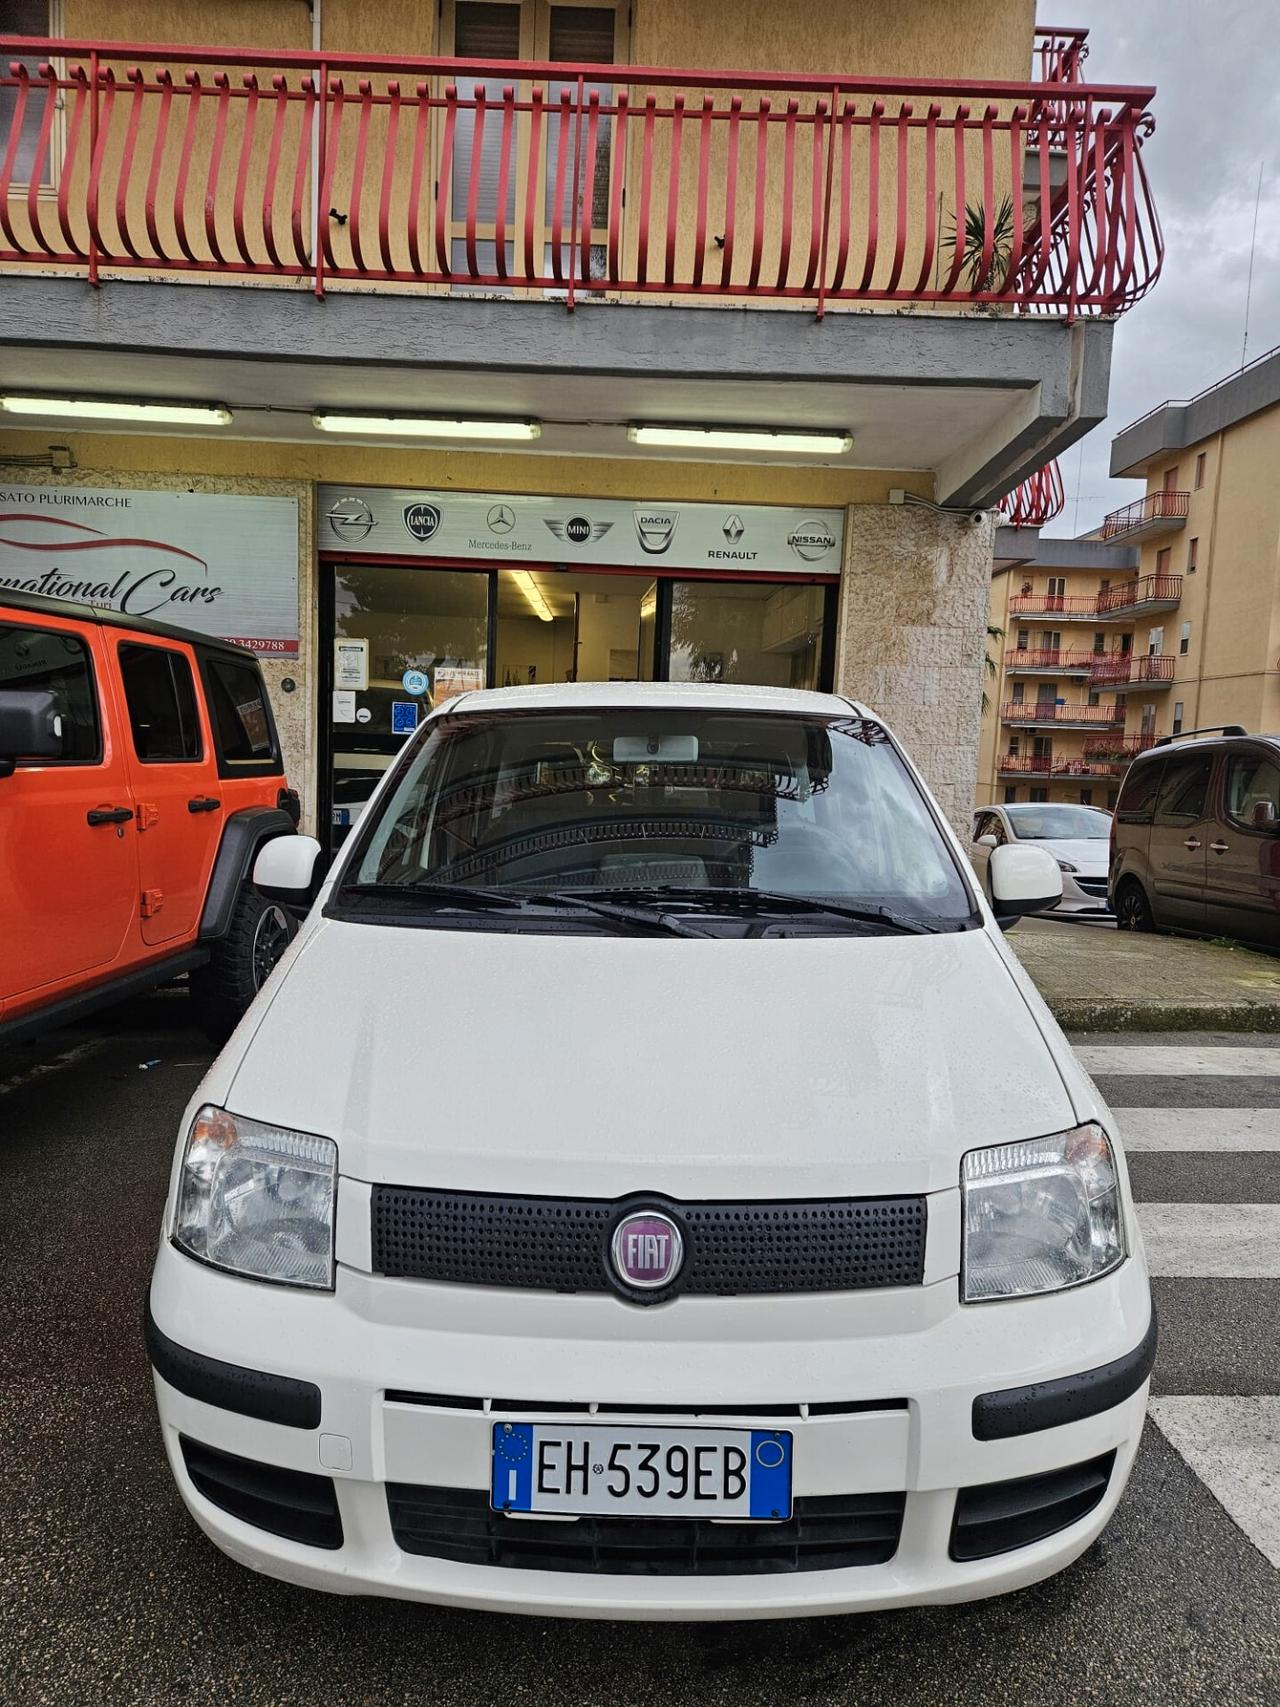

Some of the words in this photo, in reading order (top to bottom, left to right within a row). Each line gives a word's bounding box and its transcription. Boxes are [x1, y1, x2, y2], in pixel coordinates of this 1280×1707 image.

[0, 493, 35, 504] SATO
[39, 493, 133, 508] PLURIMARCHE
[410, 515, 435, 527] LANCIA
[640, 516, 671, 525] DACIA
[567, 525, 590, 535] MINI
[468, 539, 533, 551] Mercedes-Benz
[791, 535, 832, 545] NISSAN
[707, 550, 759, 560] RENAULT
[0, 567, 130, 598] national
[120, 568, 225, 616] Cars
[627, 1234, 669, 1269] FIAT
